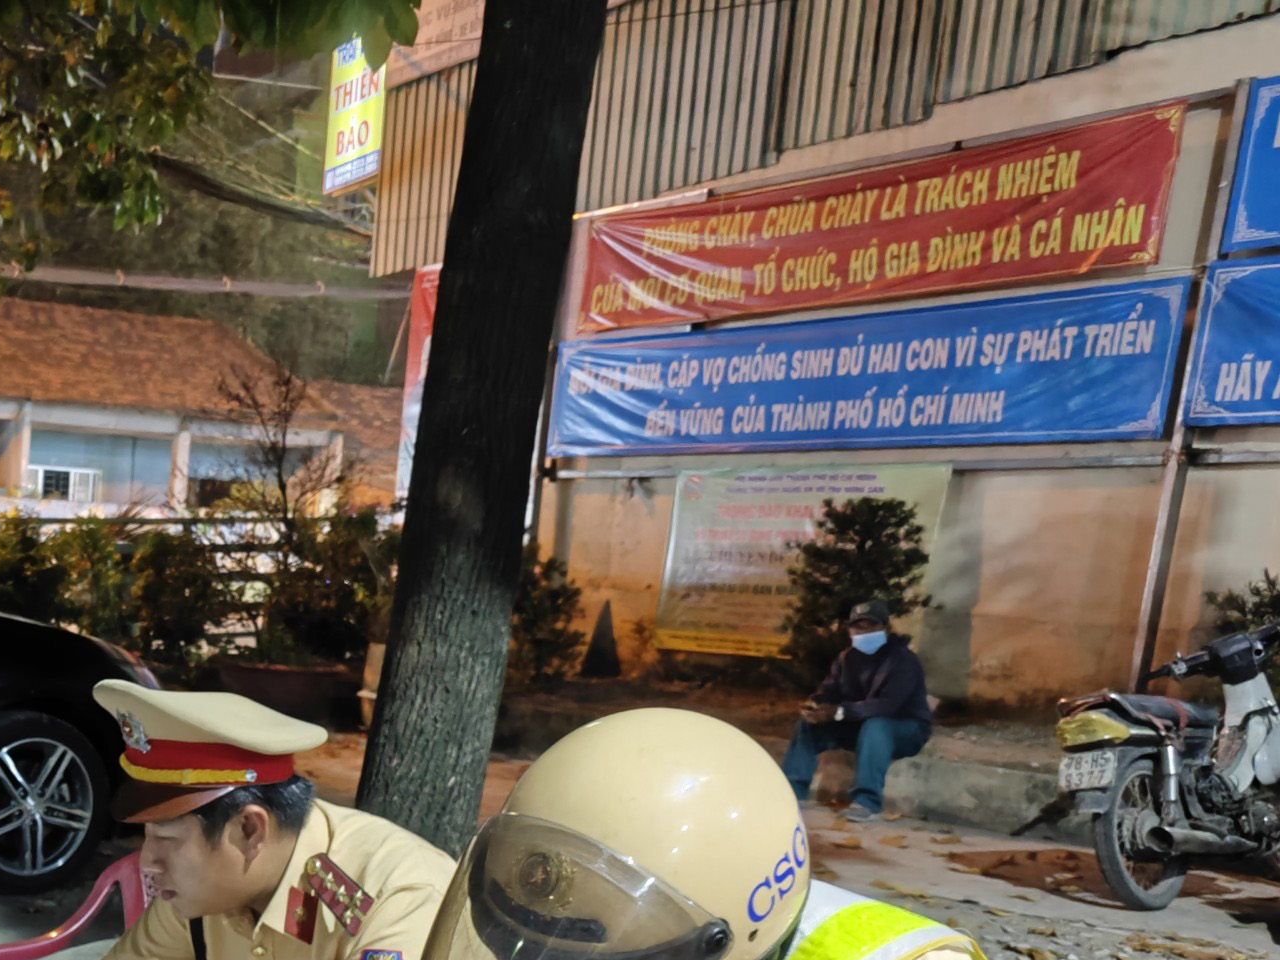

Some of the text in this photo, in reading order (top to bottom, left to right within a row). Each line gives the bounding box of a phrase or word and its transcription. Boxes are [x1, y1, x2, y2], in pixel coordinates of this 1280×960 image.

[704, 205, 756, 248] CHÁY,
[761, 195, 816, 240] CHỮA
[820, 183, 880, 232] CHÁY
[880, 174, 909, 221] LÀ
[913, 164, 991, 216] TRÁCH
[995, 145, 1082, 203] NHIỆM
[591, 273, 623, 314] CỦA
[753, 246, 780, 296] TỔ
[782, 247, 841, 293] CHỨC,
[847, 238, 878, 290] HỘ
[884, 240, 920, 280] GIA
[926, 226, 987, 274] ĐÌNH
[991, 215, 1022, 263] VÀ
[1029, 207, 1065, 259] CÁ
[1070, 197, 1146, 253] NHÂN
[667, 353, 699, 395] CẶP
[702, 354, 725, 393] VỢ
[727, 342, 787, 385] CHỒNG
[790, 346, 835, 380] SINH
[837, 333, 865, 377] ĐỦ
[867, 341, 903, 375] HAI
[905, 338, 951, 372] CON
[954, 326, 978, 367] VÌ
[979, 331, 1014, 375] SỰ
[1016, 318, 1079, 363] PHÁT
[1083, 302, 1156, 359] TRIỂN
[1215, 353, 1272, 402] HÃY
[679, 402, 724, 436] VỮNG
[731, 394, 766, 435] CỦA
[771, 394, 831, 433] THÀNH
[833, 386, 878, 430] PHỐ
[876, 384, 908, 429] HỒ
[909, 385, 950, 427] CHÍ
[948, 390, 1006, 425] MINH
